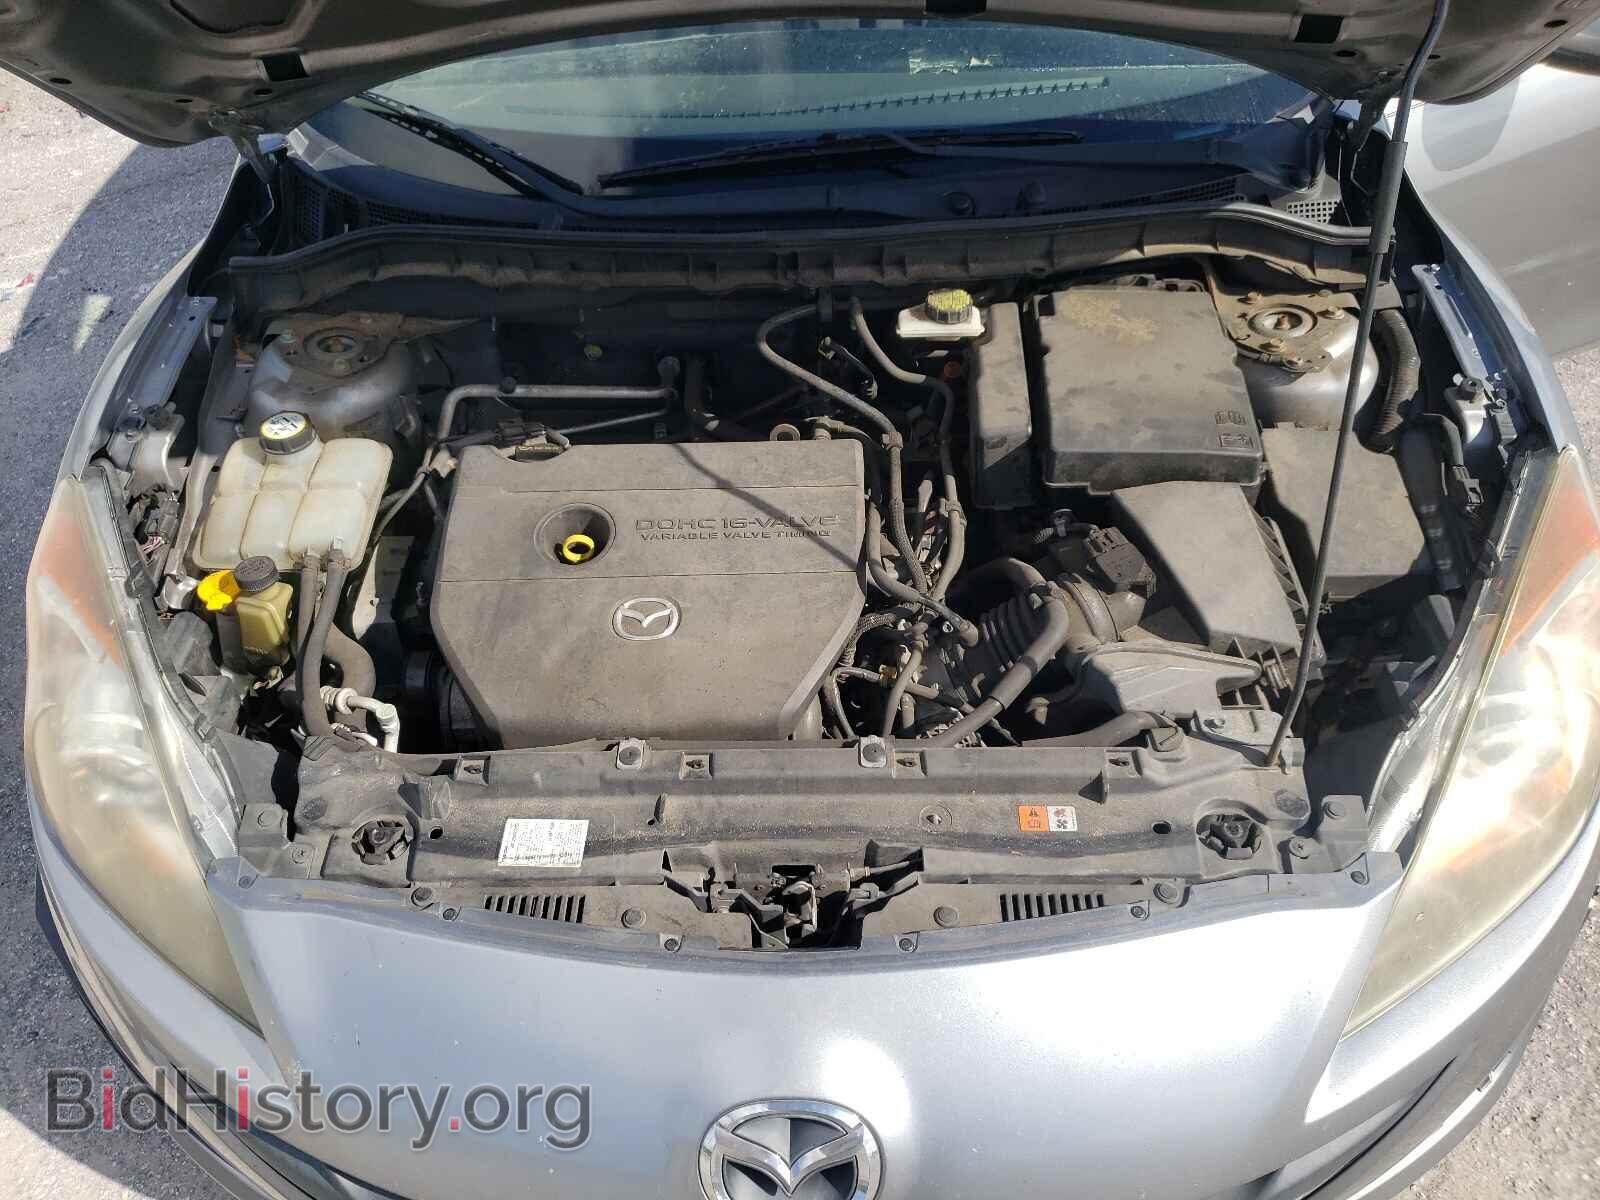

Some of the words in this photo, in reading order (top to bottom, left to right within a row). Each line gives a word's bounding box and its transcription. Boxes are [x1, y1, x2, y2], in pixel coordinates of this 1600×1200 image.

[635, 518, 715, 531] DOHC
[640, 531, 719, 541] VARIABLE
[724, 530, 772, 540] VALVE
[776, 529, 832, 539] TIMING
